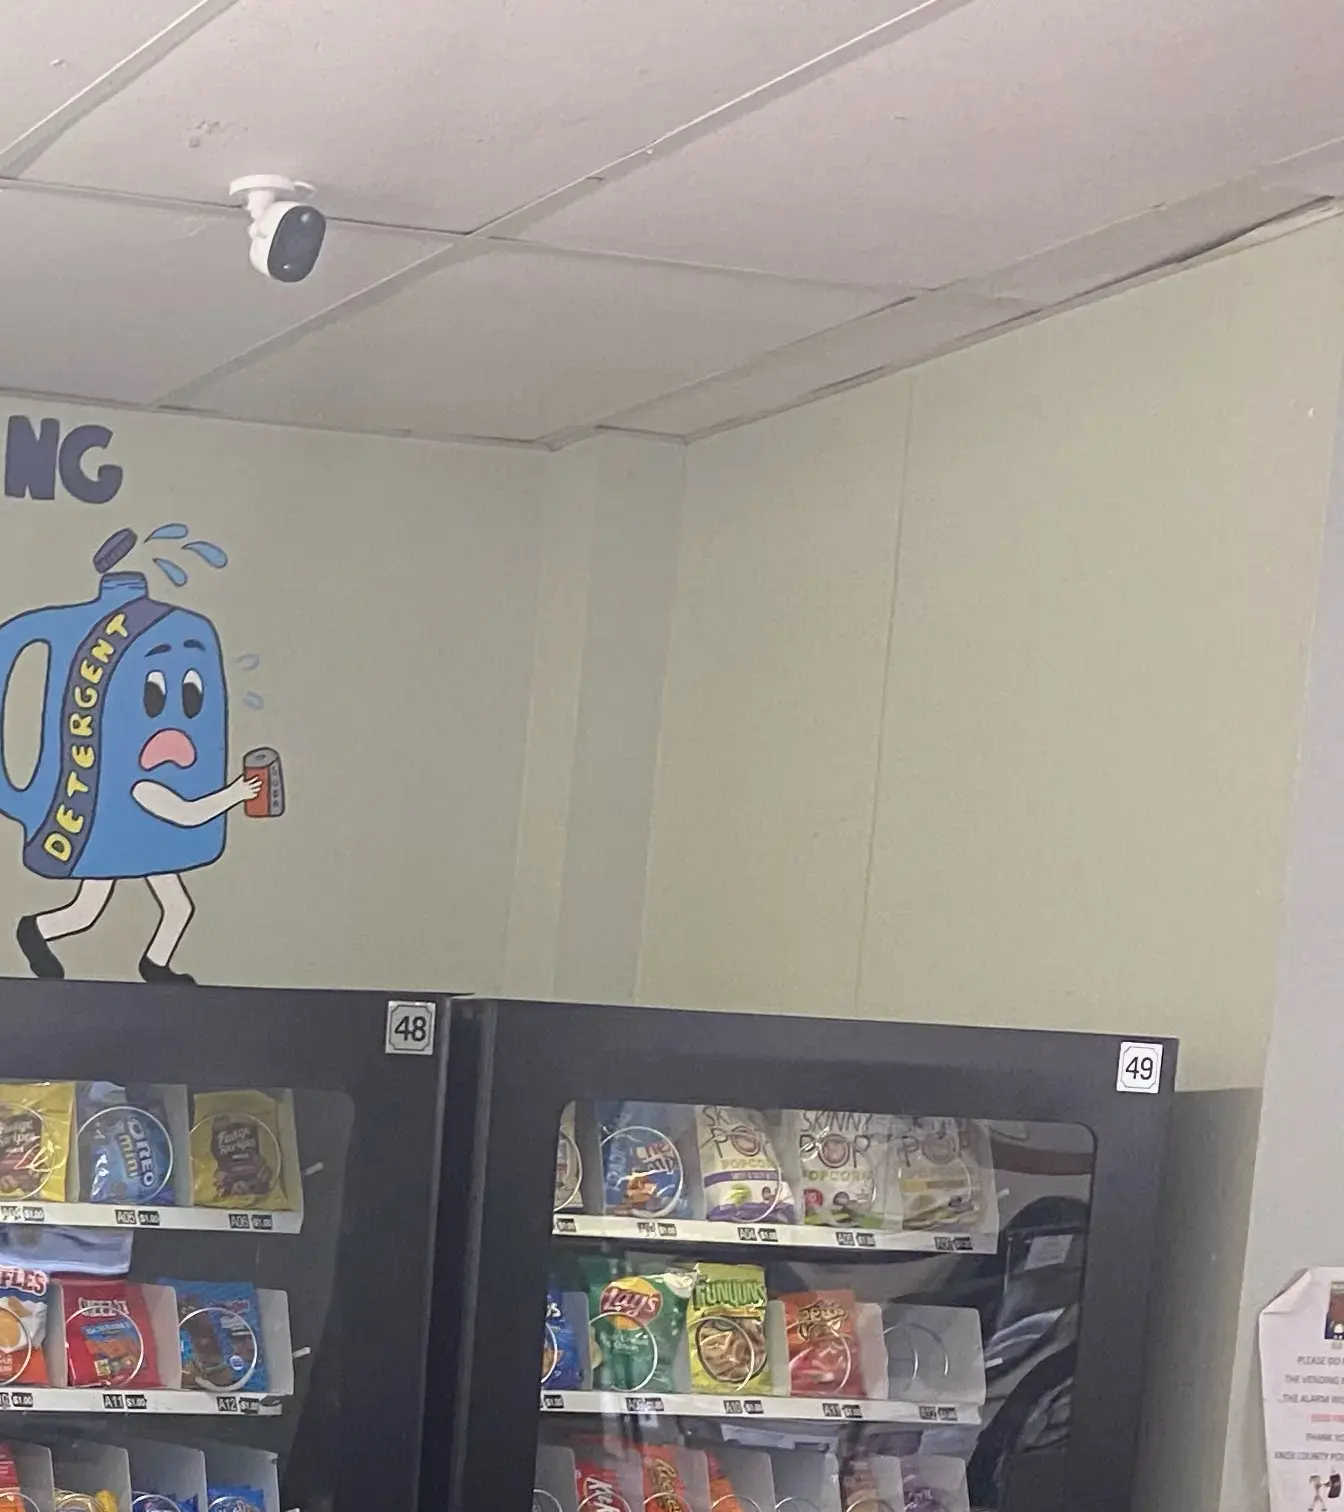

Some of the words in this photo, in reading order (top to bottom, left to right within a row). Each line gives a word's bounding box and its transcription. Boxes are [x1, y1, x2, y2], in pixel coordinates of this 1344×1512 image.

[44, 613, 128, 861] DETERGENT
[394, 1016, 427, 1042] 48
[1125, 1057, 1153, 1080] 49
[127, 1117, 156, 1187] OREO
[104, 1394, 123, 1408] A11
